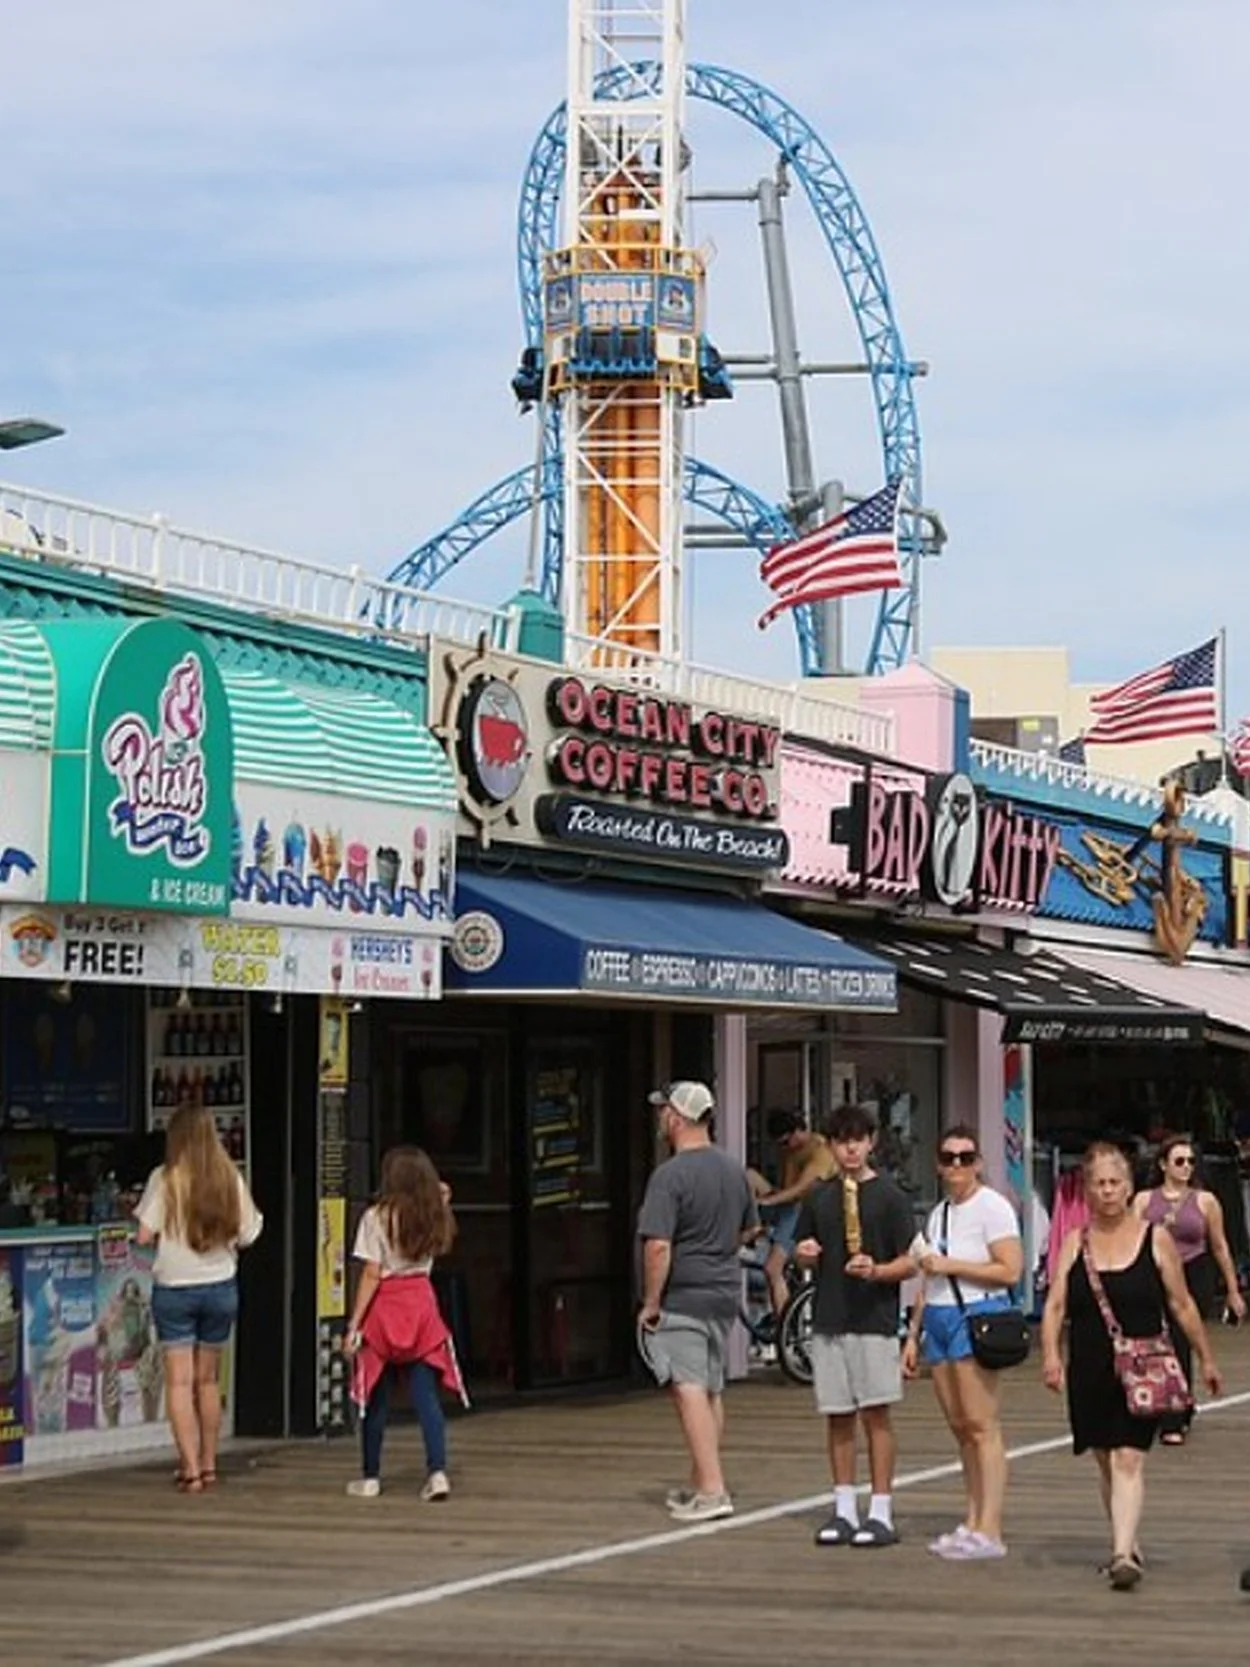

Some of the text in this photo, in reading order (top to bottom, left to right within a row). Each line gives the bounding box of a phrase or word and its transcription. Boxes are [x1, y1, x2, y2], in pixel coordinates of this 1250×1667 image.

[559, 681, 778, 766] OCEAN CITY
[560, 737, 780, 817] COFFEE CO.
[567, 805, 656, 843] Roasted
[656, 821, 681, 850] On
[682, 825, 714, 852] The
[868, 781, 928, 888] BAD
[163, 878, 182, 903] ICE
[184, 880, 226, 907] CREAM
[64, 940, 144, 976] FREE!
[586, 950, 630, 982] COFFEE
